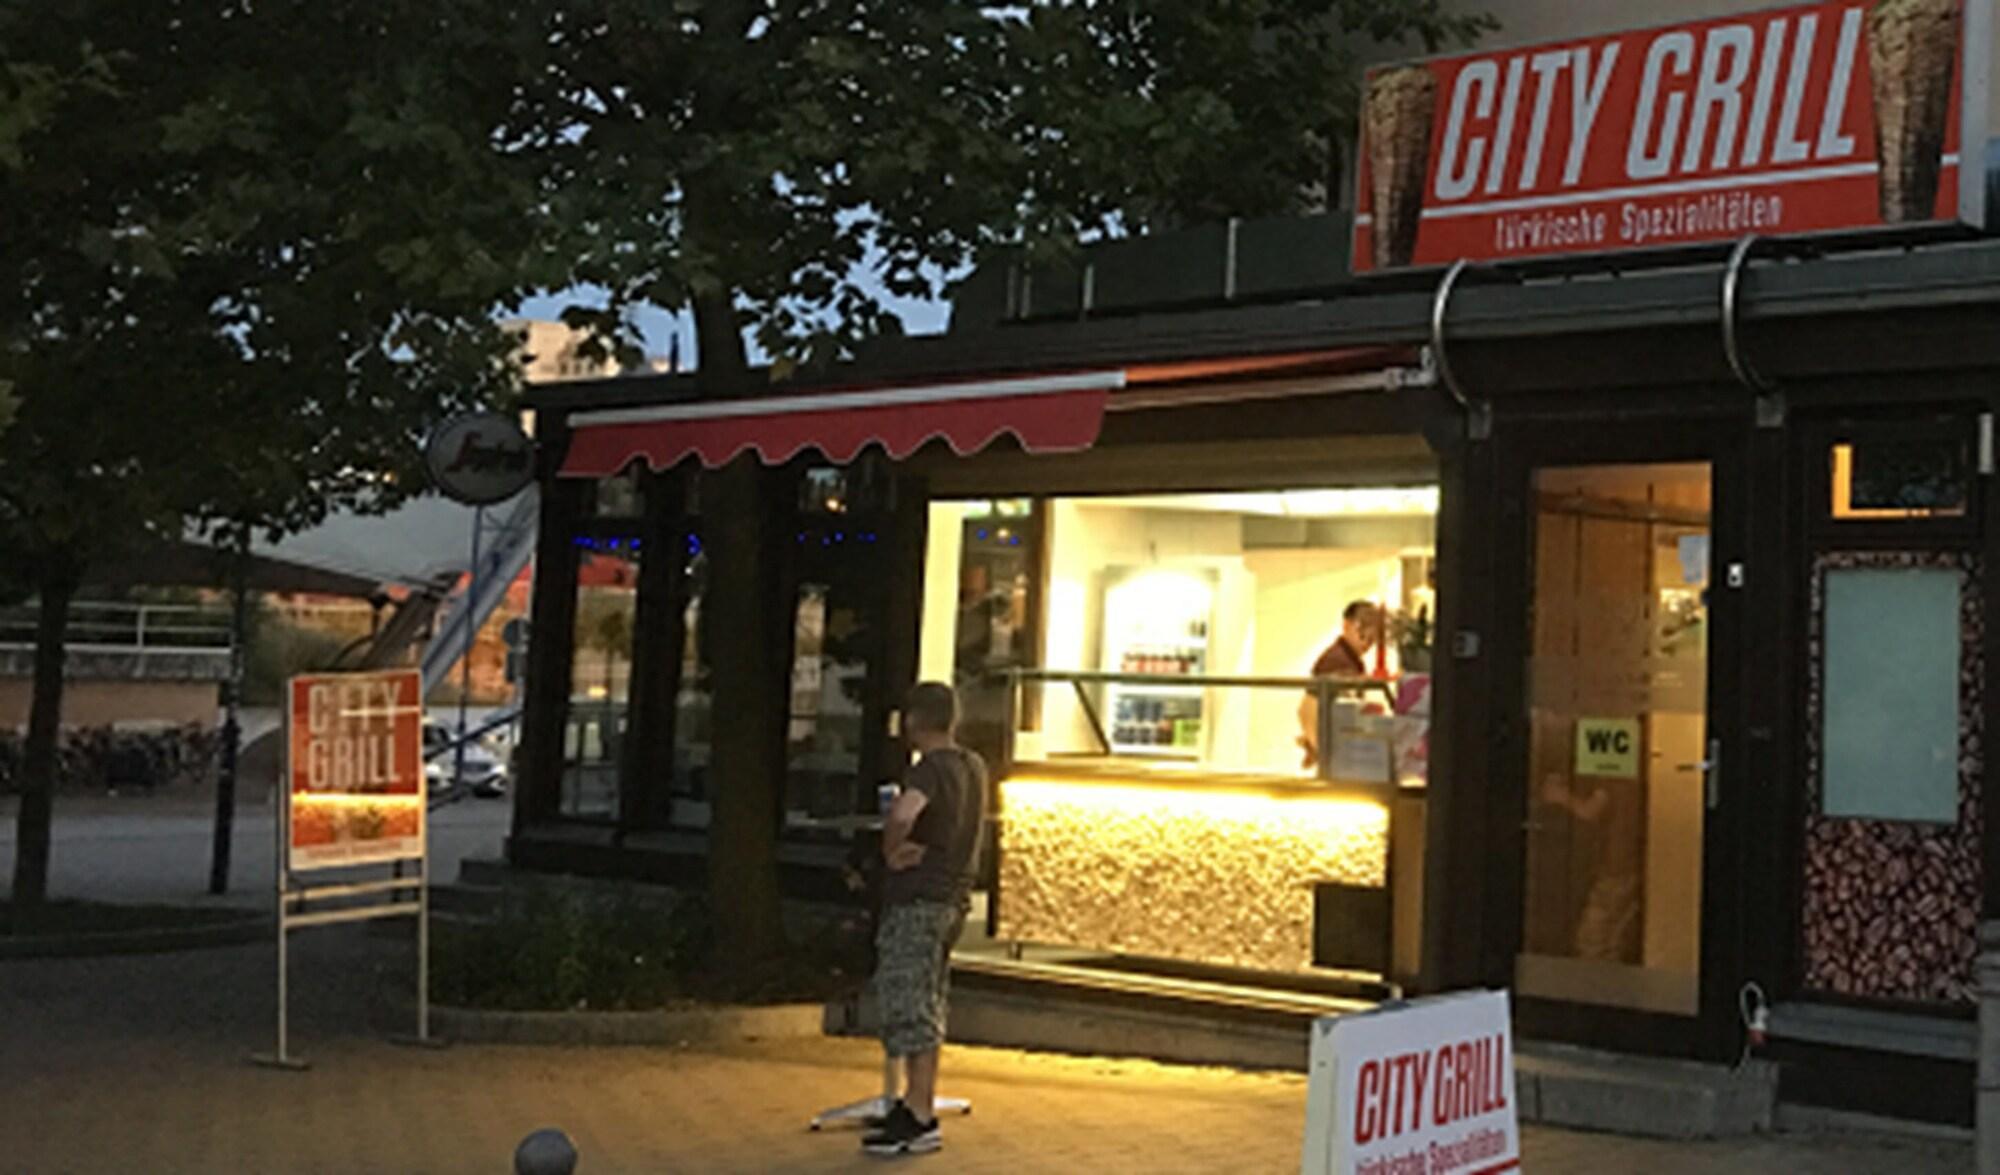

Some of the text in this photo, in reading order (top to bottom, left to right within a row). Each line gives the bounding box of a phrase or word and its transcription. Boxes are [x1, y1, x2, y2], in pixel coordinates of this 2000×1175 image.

[1434, 8, 1864, 201] CITY GRILL
[1620, 190, 1782, 243] Spezialitäten
[308, 680, 401, 734] CITY
[308, 734, 402, 788] GRILL
[1584, 728, 1630, 755] WC
[1354, 1034, 1507, 1146] CITY GRILL
